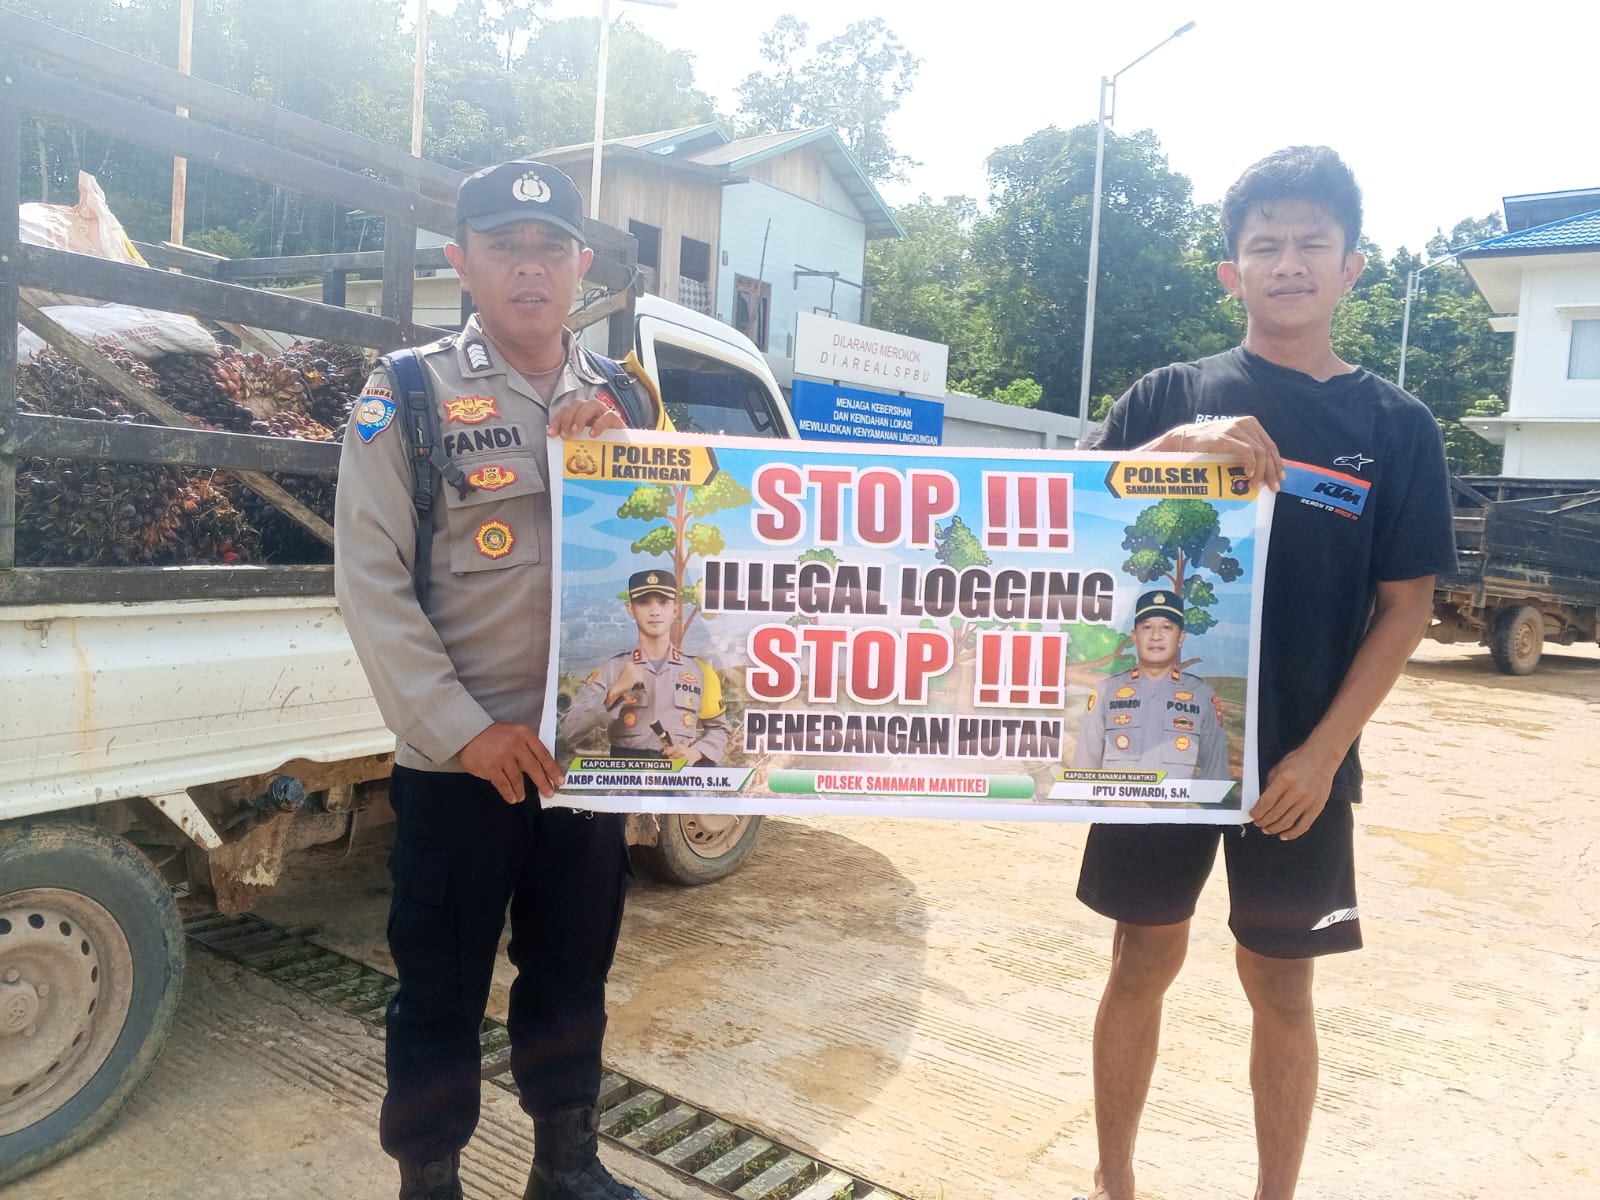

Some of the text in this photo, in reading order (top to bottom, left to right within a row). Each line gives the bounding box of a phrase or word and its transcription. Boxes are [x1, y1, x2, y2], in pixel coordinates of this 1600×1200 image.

[832, 334, 921, 363] DILARANG MEROKOK
[841, 356, 889, 375] AREAL
[894, 366, 930, 382] SPBU
[836, 397, 912, 417] MENJAGA KEBERSIHAN
[833, 411, 913, 430] DAN KEINDAHAN LOKASI
[443, 426, 522, 458] FANDI
[799, 420, 939, 445] MEWUJUDKAN KENYAMANAN LINGKUNGAN
[612, 445, 692, 467] POLRES
[612, 464, 692, 481] KATINGAN
[1123, 466, 1209, 483] POLSEK
[1126, 485, 1208, 495] SANAMAN MANTIKEI
[1313, 482, 1361, 505] KTM
[754, 465, 1071, 549] STOP !!!
[703, 561, 1115, 623] ILLEGAL LOGGING
[749, 625, 1062, 706] STOP !!!
[1166, 700, 1200, 714] POLRI
[746, 712, 1061, 759] PENEBANGAN HUTAN
[582, 760, 671, 769] KAPOLRES KATINGAN
[567, 775, 731, 788] AKBP CHANDRA ISMAWANTO, S.I.K.
[817, 774, 987, 794] POLSEK SANAMAN MANTIKEI
[1065, 772, 1096, 780] KAPOLSEK
[1092, 786, 1190, 799] IPTU SUWARDI, S.H.
